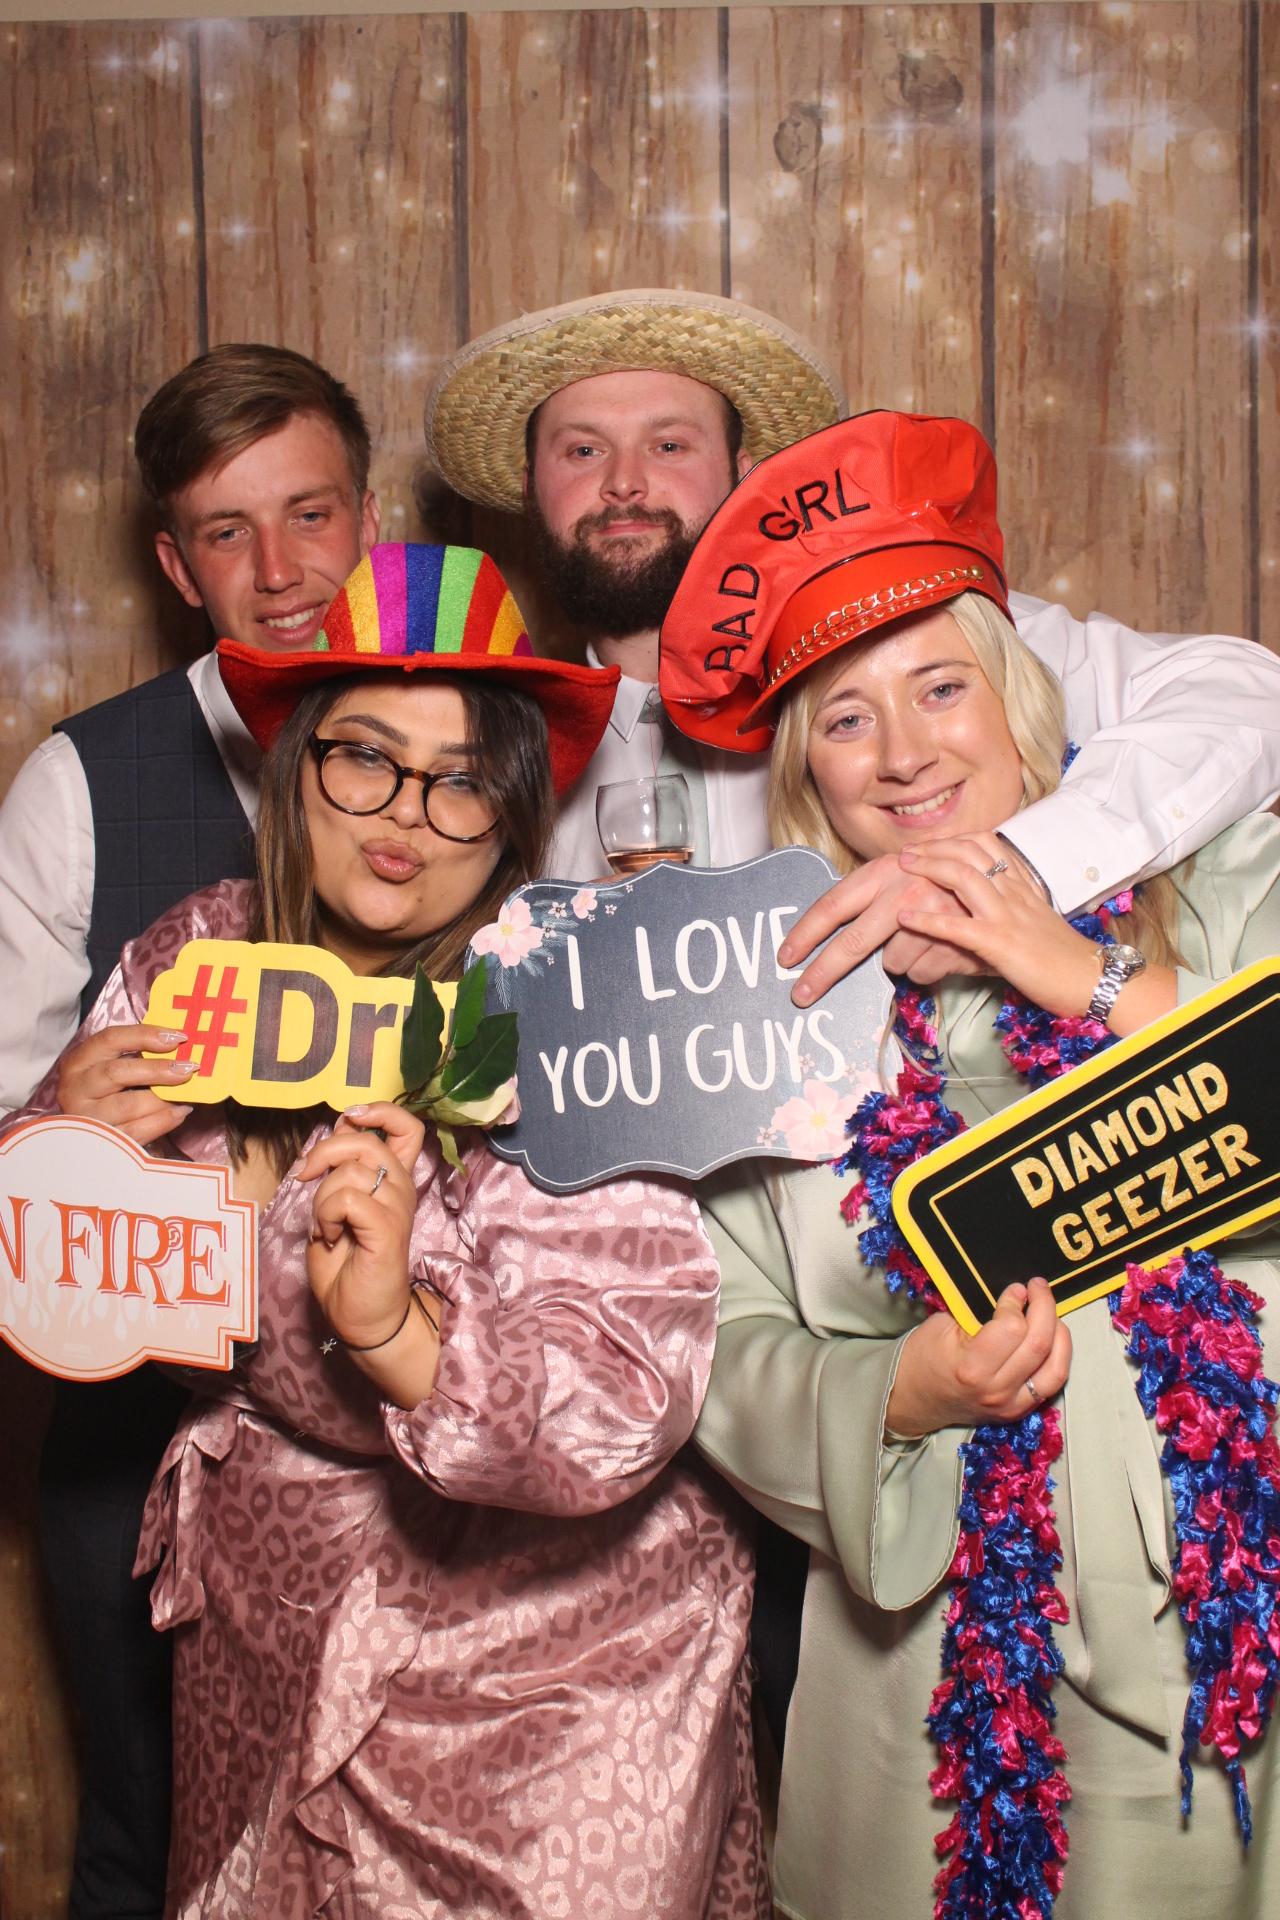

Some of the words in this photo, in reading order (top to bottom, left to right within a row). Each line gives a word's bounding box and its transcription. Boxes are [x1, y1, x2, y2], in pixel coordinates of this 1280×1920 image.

[704, 563, 760, 672] BAD
[567, 934, 584, 1010] I
[635, 906, 804, 1000] LOVE
[538, 1033, 661, 1115] YOU
[685, 1010, 846, 1093] GUYS
[1011, 1062, 1229, 1209] DIAMOND
[1052, 1123, 1261, 1261] GEEZER
[50, 1200, 231, 1309] FIRE
